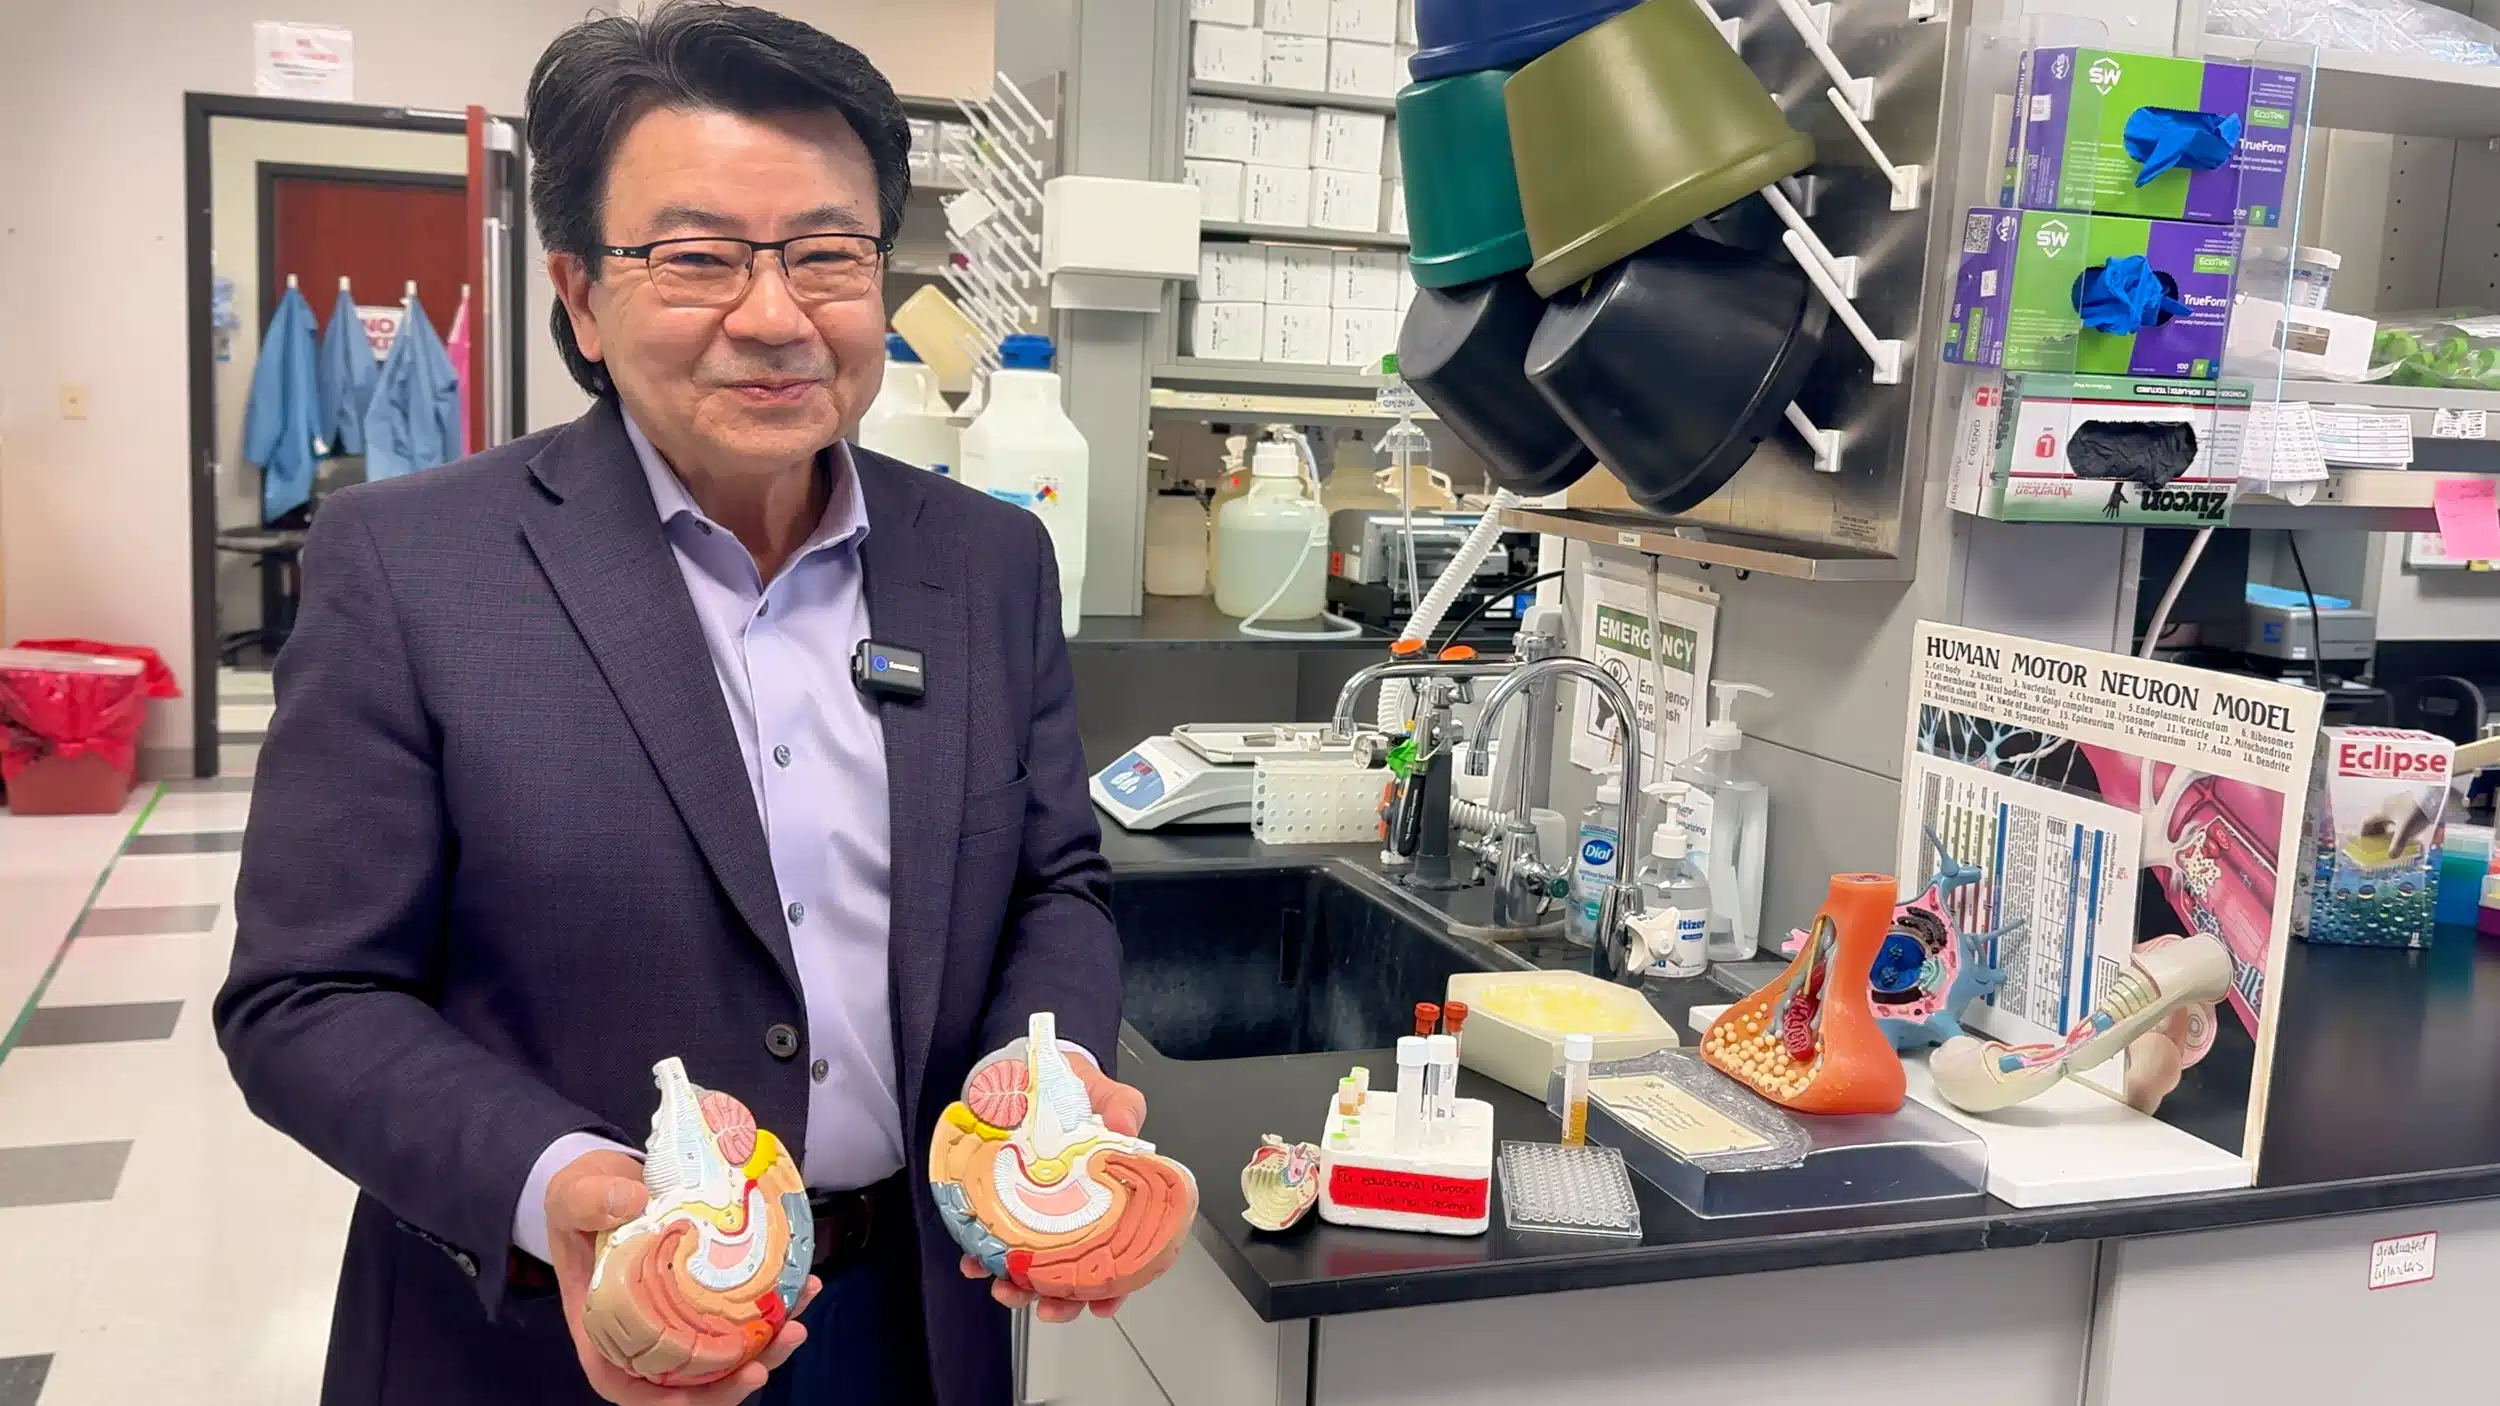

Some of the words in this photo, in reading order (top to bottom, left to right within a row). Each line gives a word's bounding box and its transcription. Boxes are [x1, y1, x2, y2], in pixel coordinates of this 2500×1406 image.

[2089, 66, 2122, 86] SW
[2239, 138, 2287, 154] TrueForm
[2036, 231, 2070, 248] SW
[2184, 294, 2227, 308] TrueForm
[2141, 490, 2228, 520] Zircon
[1600, 616, 1695, 663] EMERGNCY
[1926, 636, 2000, 670] HUMAN
[2011, 653, 2087, 688] MOTOR
[2100, 670, 2199, 711] NEURON
[2212, 693, 2295, 733] MODEL
[1638, 700, 1654, 715] eye
[1943, 673, 1977, 689] membrane
[2003, 687, 2027, 700] bodies
[2062, 700, 2093, 714] complex
[2118, 711, 2155, 728] Lysosome
[2180, 726, 2209, 741] Vesicle
[2234, 738, 2293, 761] Mitochondrion
[2022, 681, 2056, 696] Nucleolus
[2187, 717, 2229, 733] reticulum
[2250, 730, 2294, 750] Ribosomes
[1956, 686, 1977, 699] sheath
[2071, 713, 2115, 731] Epineurium
[2138, 728, 2187, 748] Perineurium
[2210, 745, 2232, 758] Axon
[2256, 755, 2291, 773] Dendrite
[2015, 711, 2046, 726] Synaptic
[2047, 717, 2069, 731] knobs
[2339, 744, 2447, 777] Eclipse
[1584, 844, 1612, 861] Dial
[1677, 919, 1706, 930] itizer
[1362, 1176, 1425, 1191] educational
[1431, 1183, 1477, 1196] purposes
